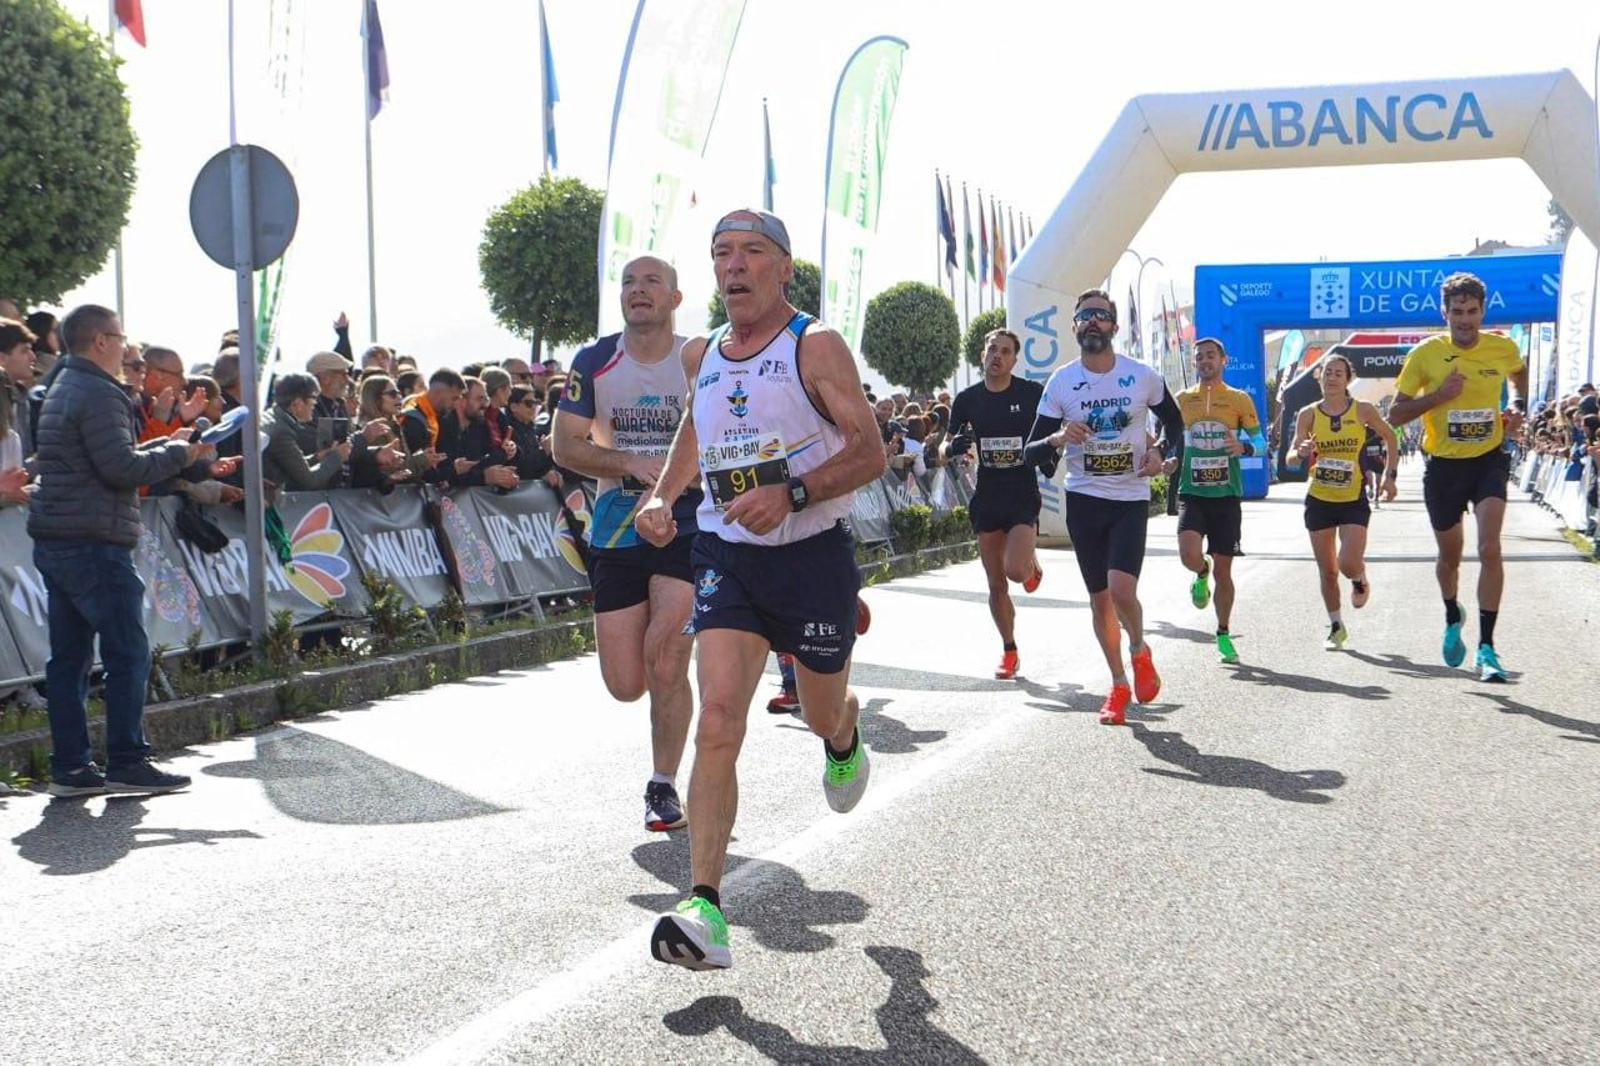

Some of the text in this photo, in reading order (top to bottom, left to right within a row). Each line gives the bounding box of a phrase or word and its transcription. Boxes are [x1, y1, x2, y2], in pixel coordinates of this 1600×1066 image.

[1359, 294, 1391, 313] DE
[1363, 355, 1407, 367] POWE
[1081, 396, 1132, 411] MADRID
[612, 407, 658, 418] NOCTURNA
[614, 416, 672, 433] OURENSE
[1461, 423, 1486, 436] 905
[993, 450, 1015, 461] 525
[1093, 455, 1129, 469] 2562
[730, 466, 759, 493] 91
[1200, 469, 1222, 480] 350
